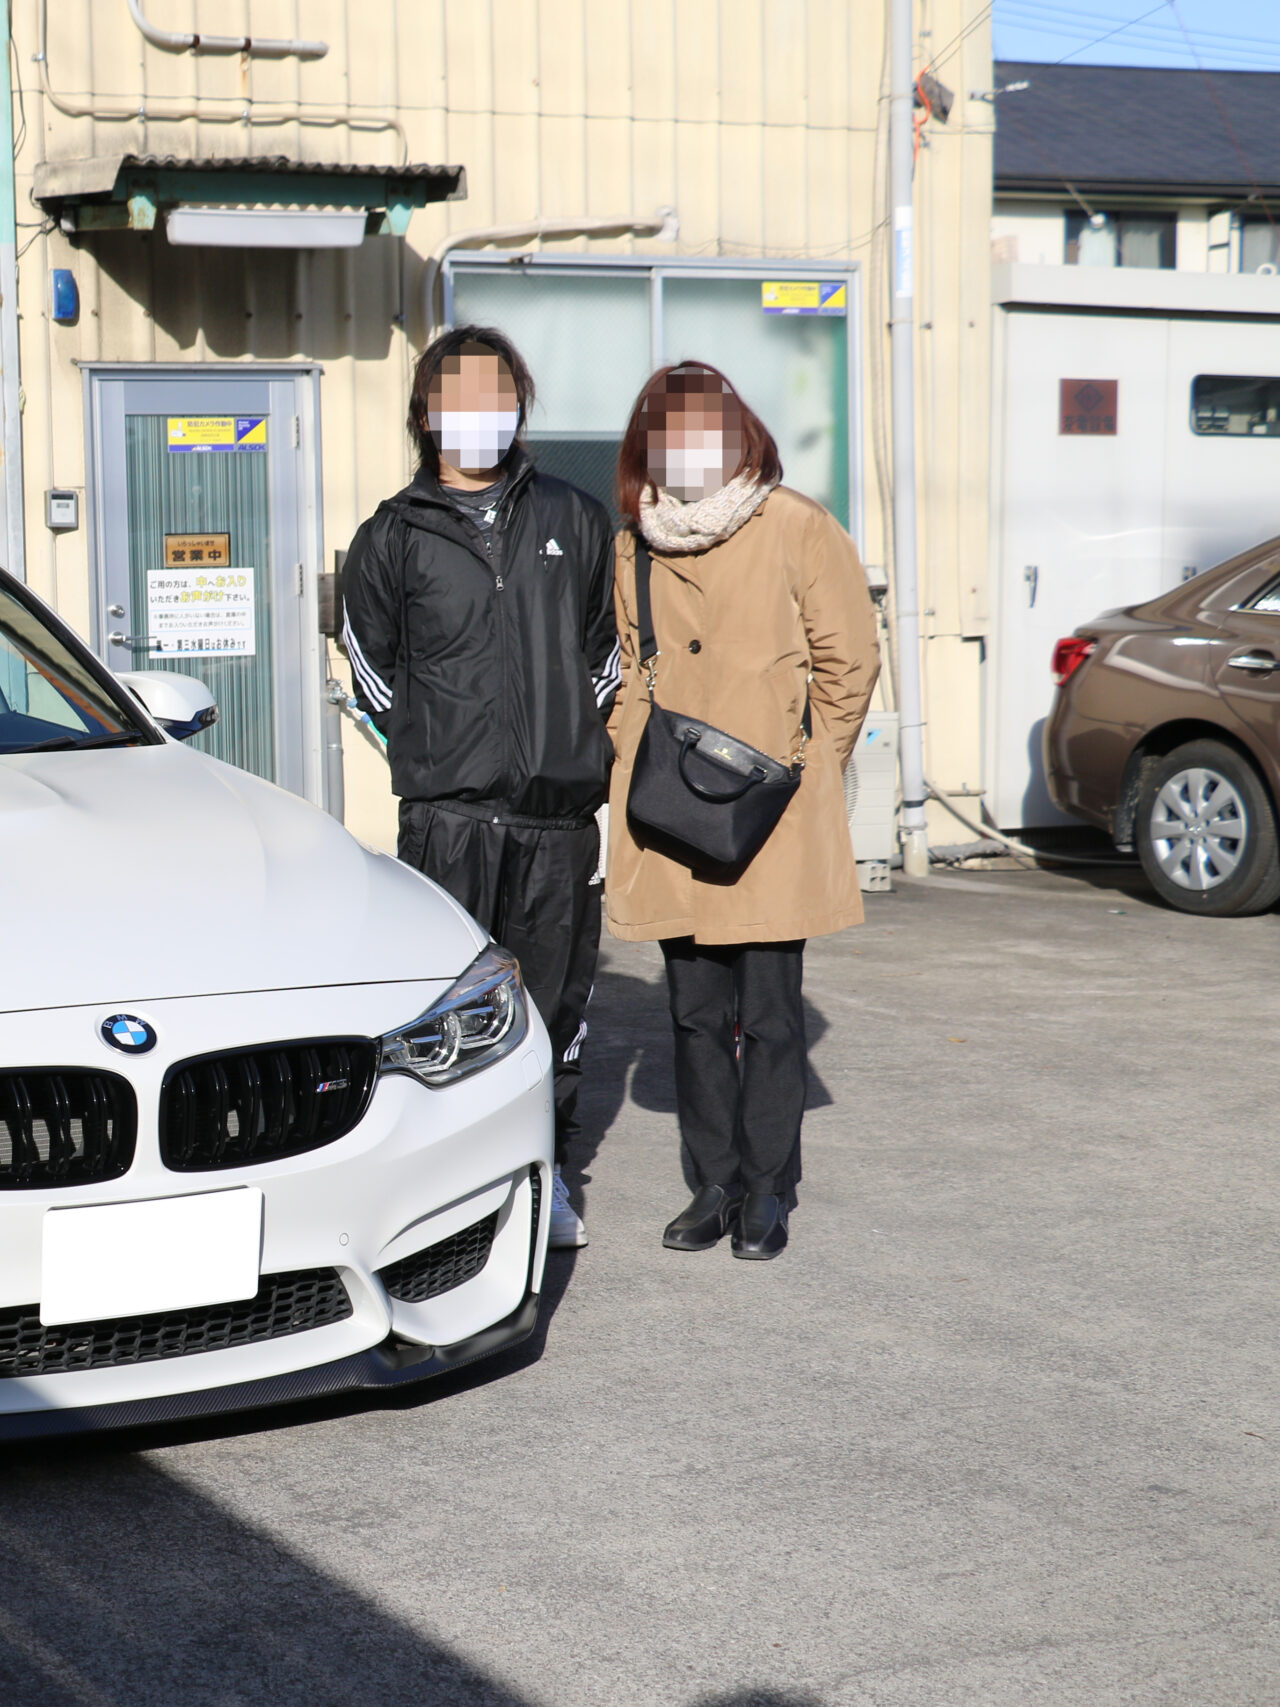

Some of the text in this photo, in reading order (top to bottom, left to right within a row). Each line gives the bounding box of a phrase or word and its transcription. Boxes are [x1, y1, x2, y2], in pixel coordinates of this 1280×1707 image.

[172, 549, 222, 562] 営業中
[103, 1014, 148, 1029] BMW
